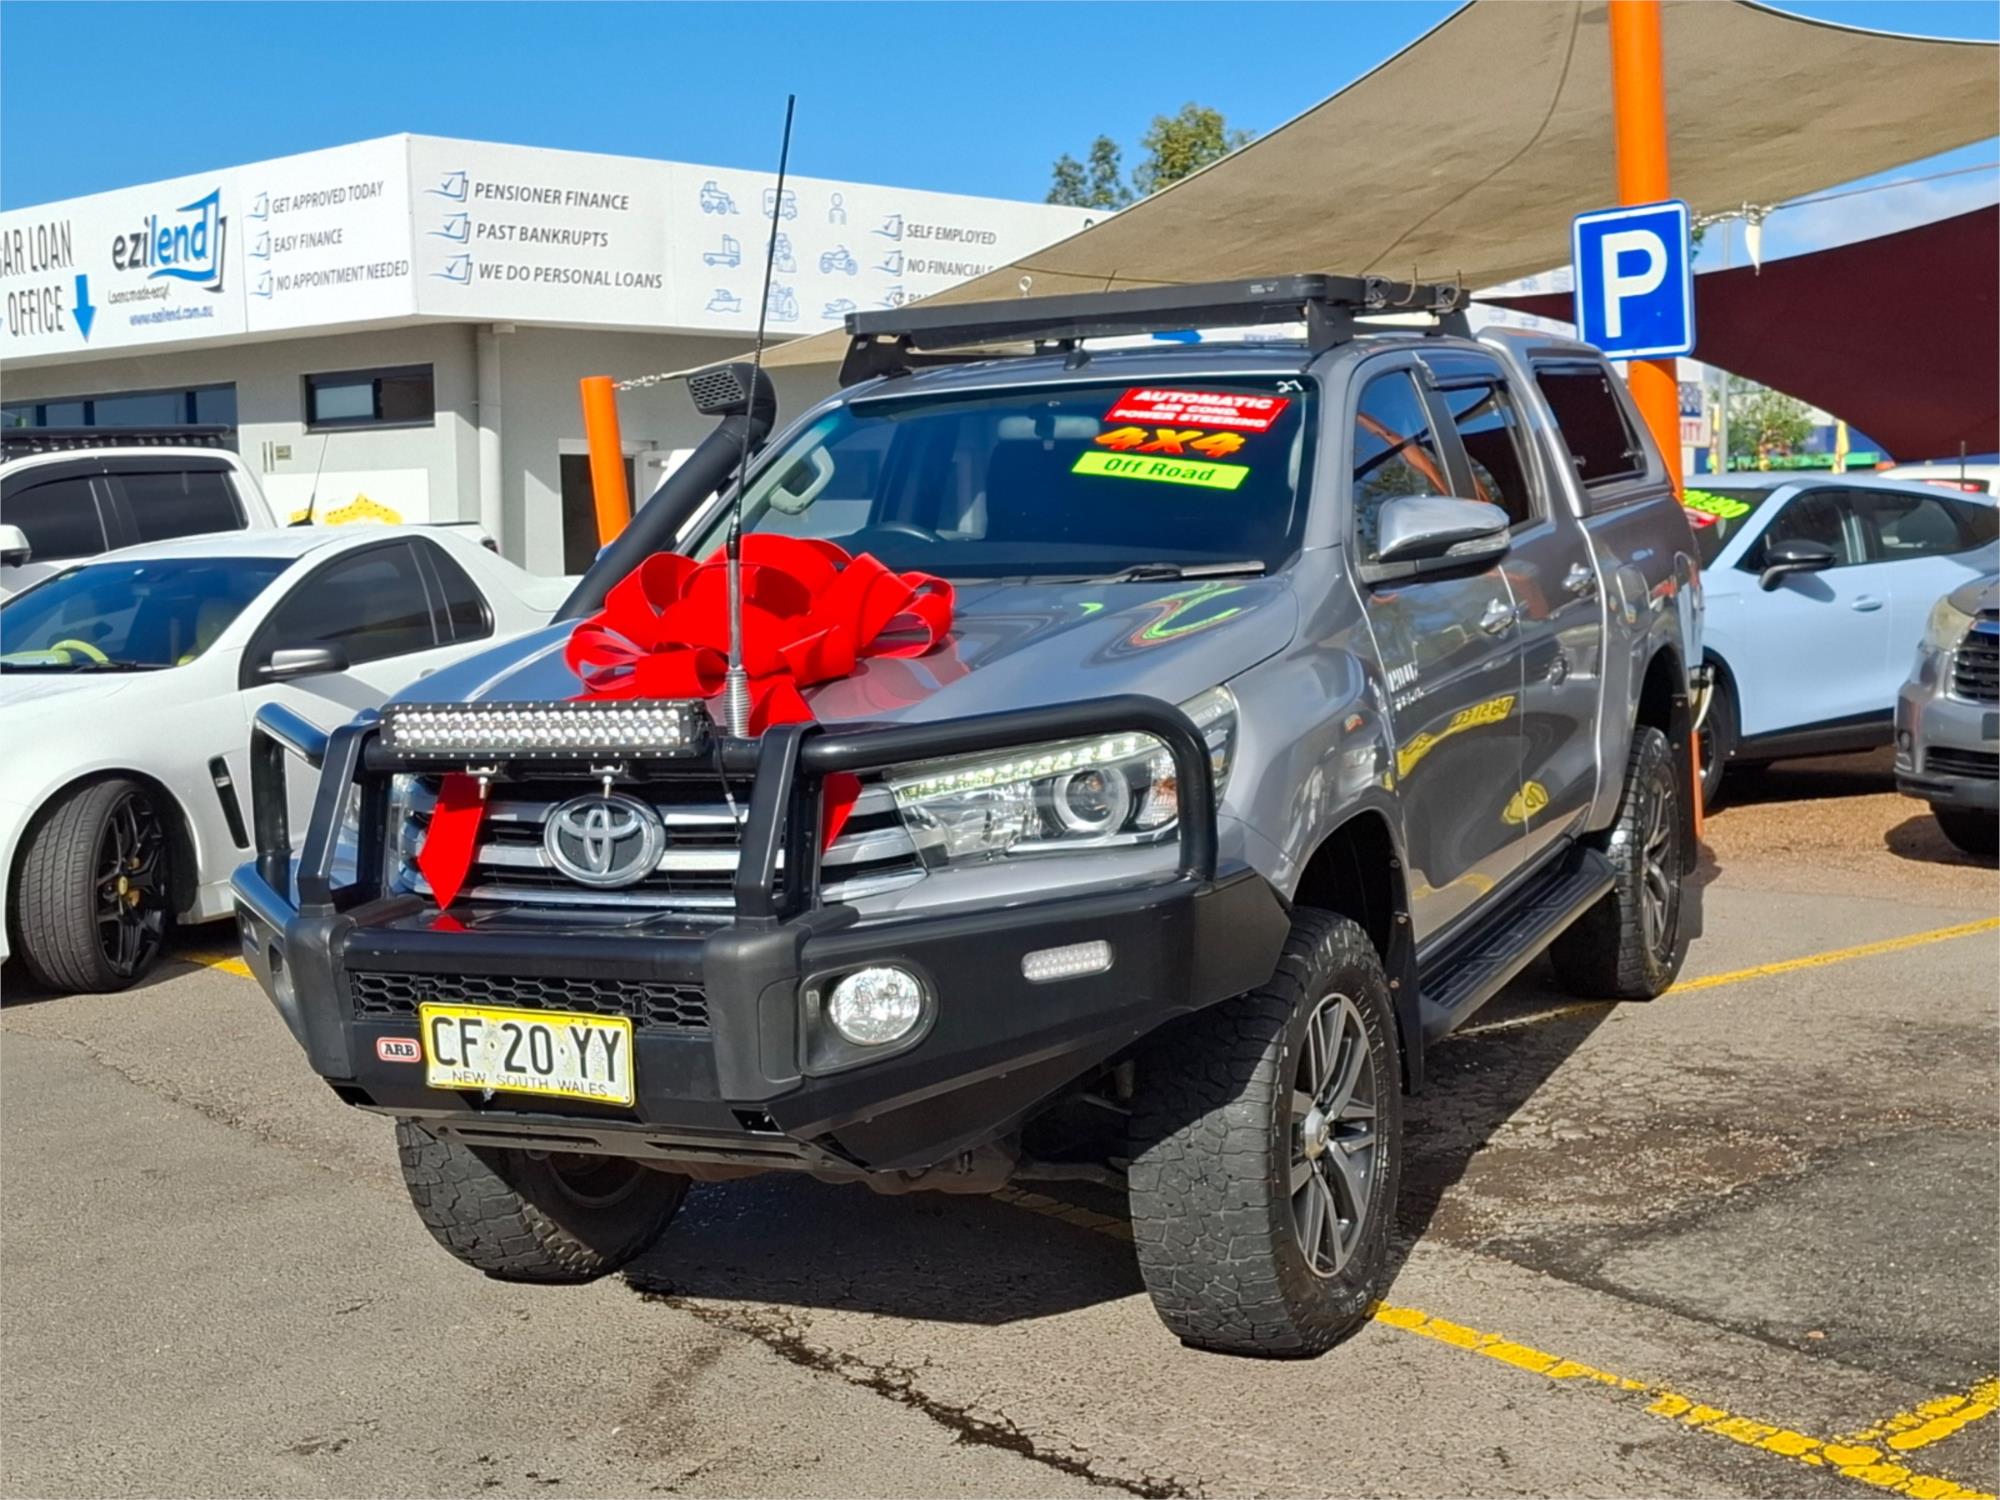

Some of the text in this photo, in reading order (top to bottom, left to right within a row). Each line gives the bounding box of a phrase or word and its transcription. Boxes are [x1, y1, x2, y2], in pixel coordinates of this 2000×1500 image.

[272, 181, 384, 214] GET APPROVED TODAY
[474, 182, 630, 210] PENSIONER FINANCE
[112, 205, 208, 272] ezilend
[274, 228, 343, 253] EASY FINANCE
[476, 223, 609, 247] PAST BANKRUPTS
[906, 223, 998, 245] SELF EMPLOYED
[0, 219, 75, 278] AR LOAN
[276, 260, 409, 291] NO APPOINTMENT NEEDED
[478, 262, 663, 289] WE DO PERSONAL LOANS
[907, 258, 926, 273] NO
[1601, 229, 1668, 339] P
[7, 285, 66, 337] OFFICE
[1133, 390, 1274, 410] AUTOMATIC
[1152, 403, 1184, 413] AIR
[1113, 409, 1268, 428] POWER STEERING
[1103, 457, 1217, 482] Off Road
[384, 1043, 415, 1056] ARB
[431, 1016, 621, 1083] CF 20 YY
[452, 1070, 608, 1098] NEW SOUTH WALES
